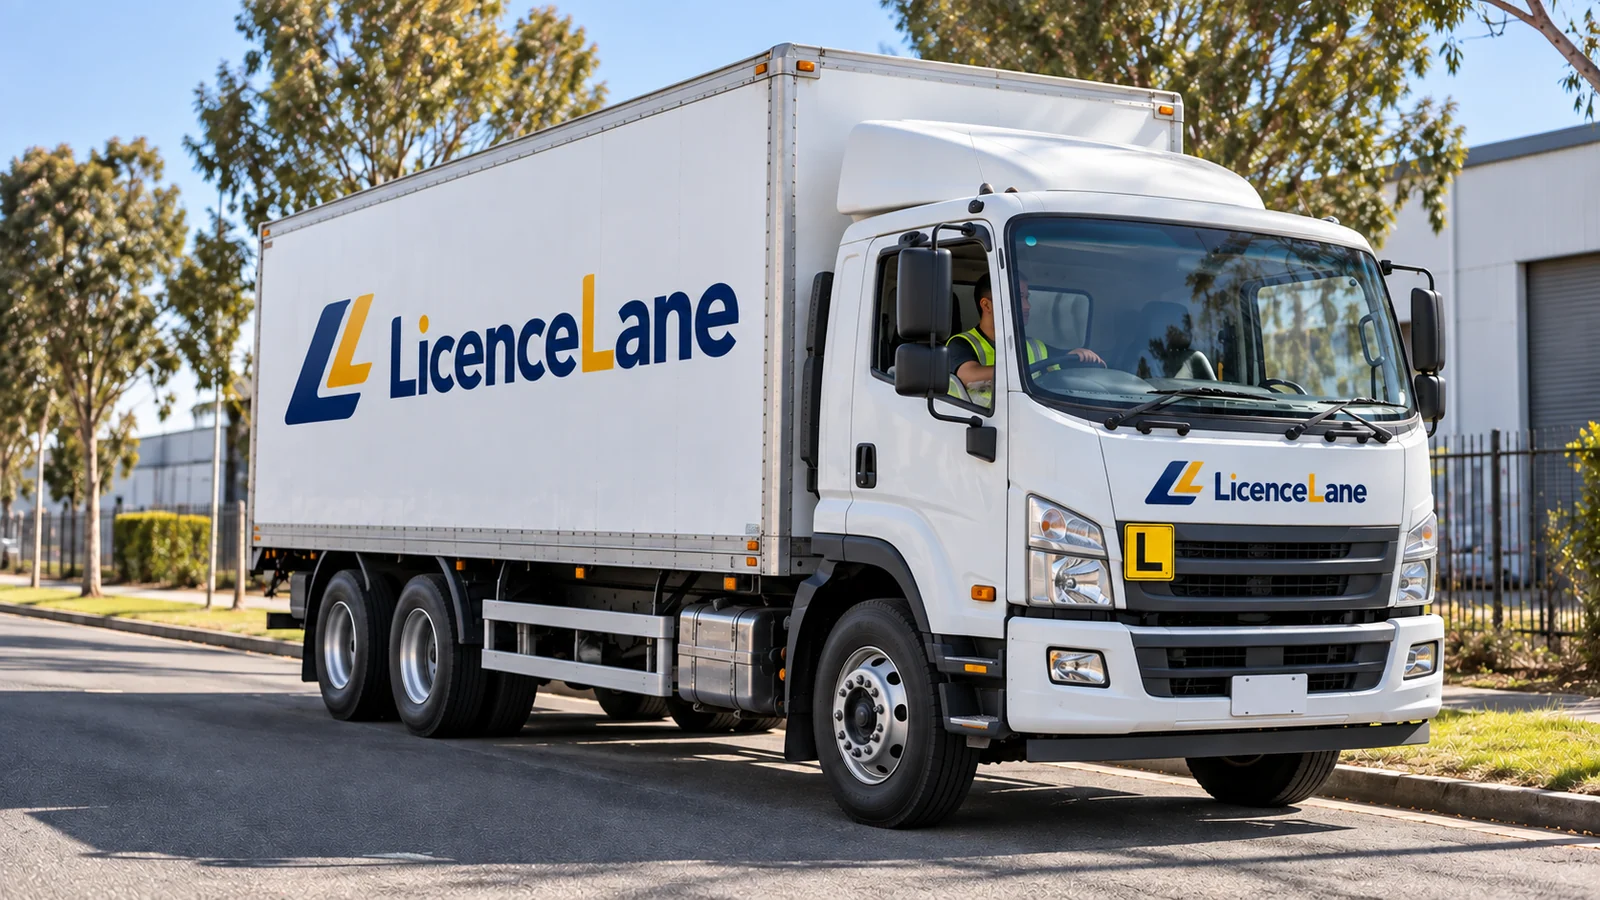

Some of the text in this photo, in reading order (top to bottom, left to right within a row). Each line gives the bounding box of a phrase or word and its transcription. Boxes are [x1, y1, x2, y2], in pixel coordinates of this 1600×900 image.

[390, 274, 739, 398] LicenceLane
[1214, 472, 1367, 504] LicenceLane
[1136, 533, 1163, 571] L
